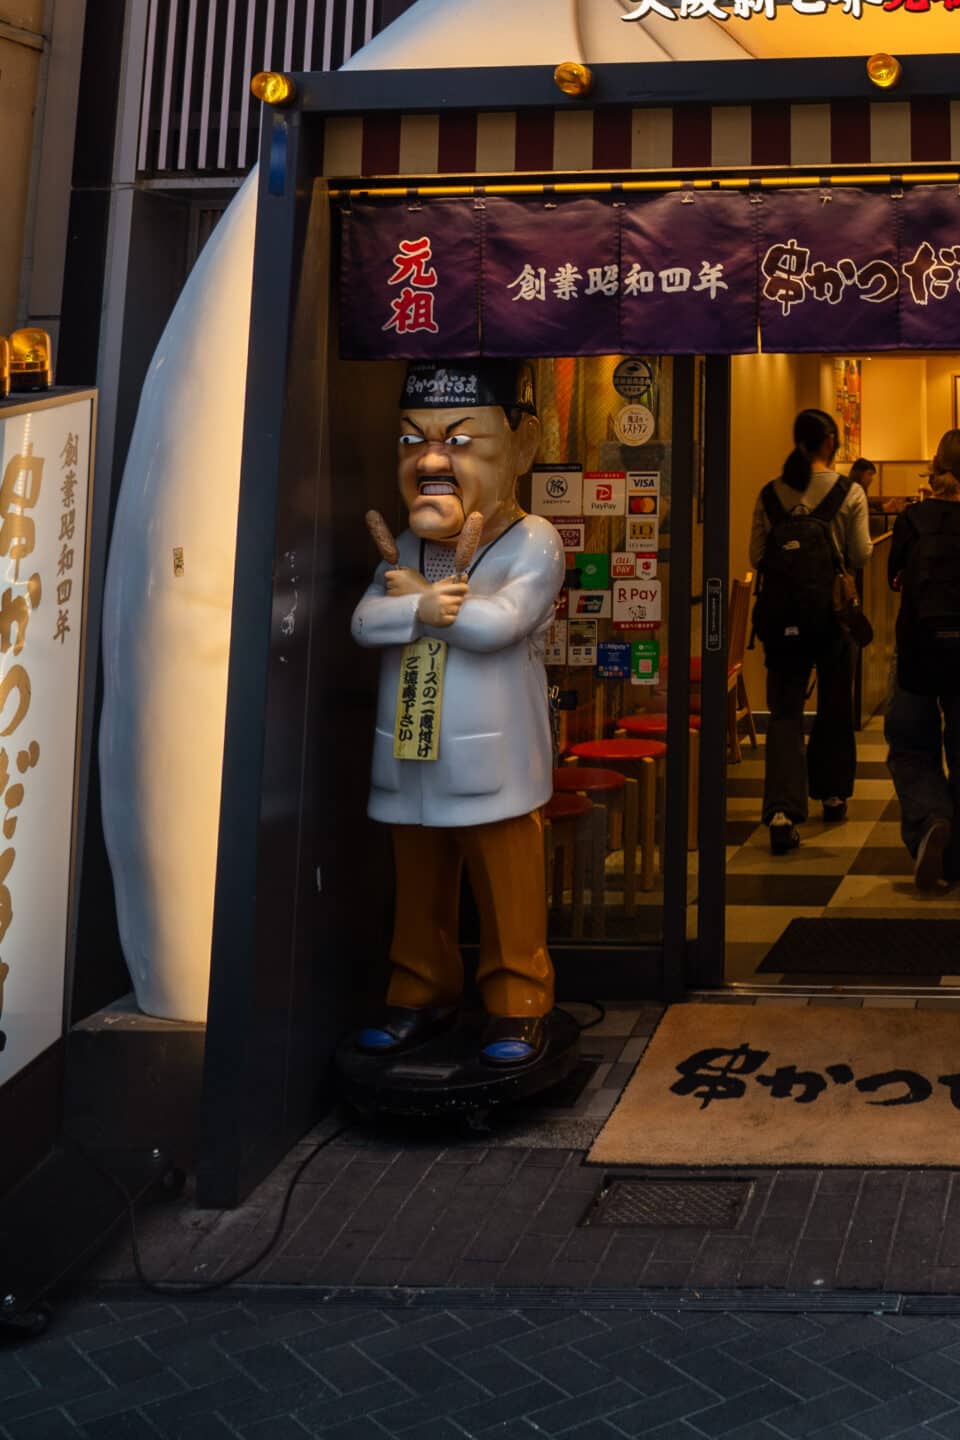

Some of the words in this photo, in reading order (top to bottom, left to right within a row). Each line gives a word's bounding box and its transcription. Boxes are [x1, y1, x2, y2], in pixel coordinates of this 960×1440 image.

[382, 236, 439, 335] 元祖
[507, 260, 729, 302] 創業昭和四年
[591, 502, 616, 512] PayPay
[633, 479, 655, 488] VISA
[53, 431, 79, 645] 創業昭和四年
[631, 588, 657, 603] Pay
[398, 656, 421, 742] ご遠慮下さい
[417, 642, 441, 758] ソースの二度付け
